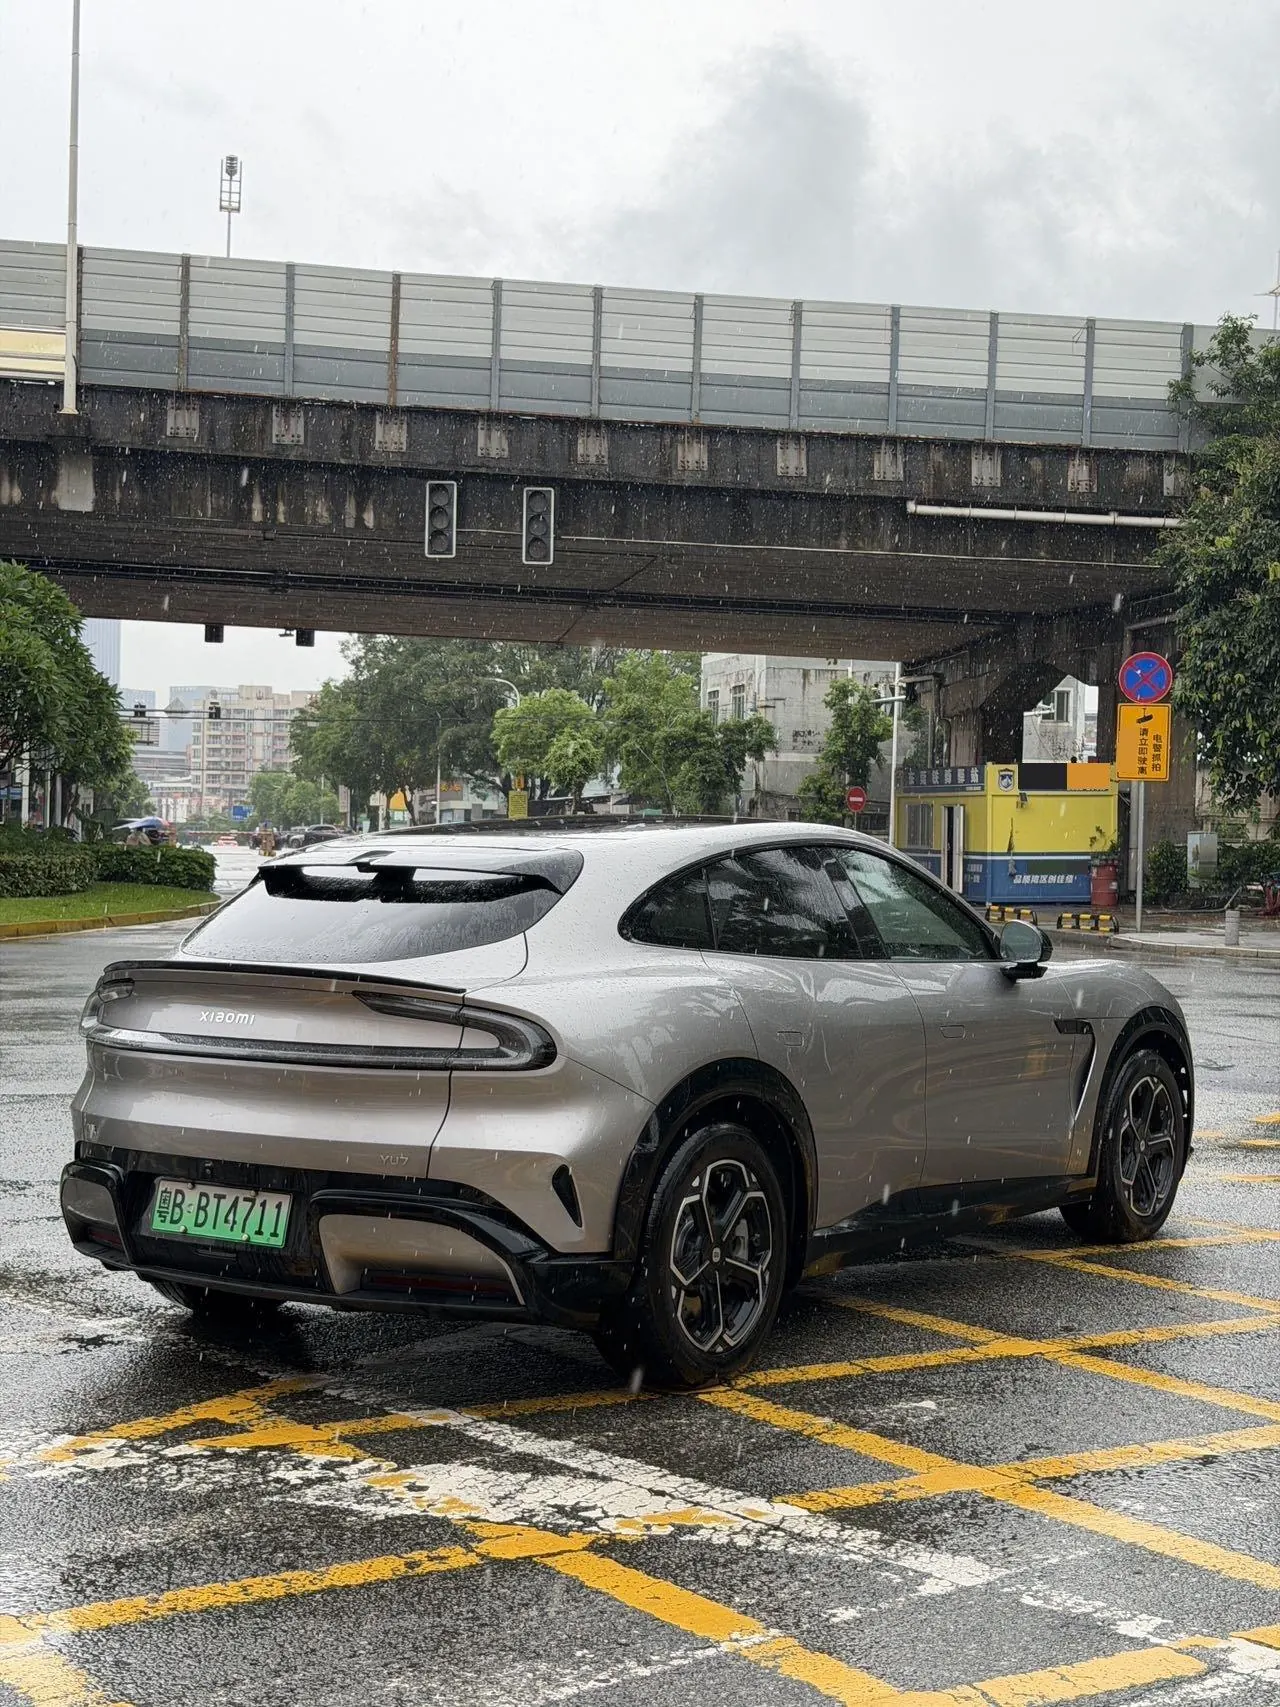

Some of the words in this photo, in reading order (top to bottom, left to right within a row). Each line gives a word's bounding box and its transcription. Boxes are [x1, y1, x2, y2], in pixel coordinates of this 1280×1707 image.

[1138, 727, 1149, 775] 请立即驶离
[1152, 734, 1162, 772] 电警抓拍
[380, 1153, 409, 1166] YU7
